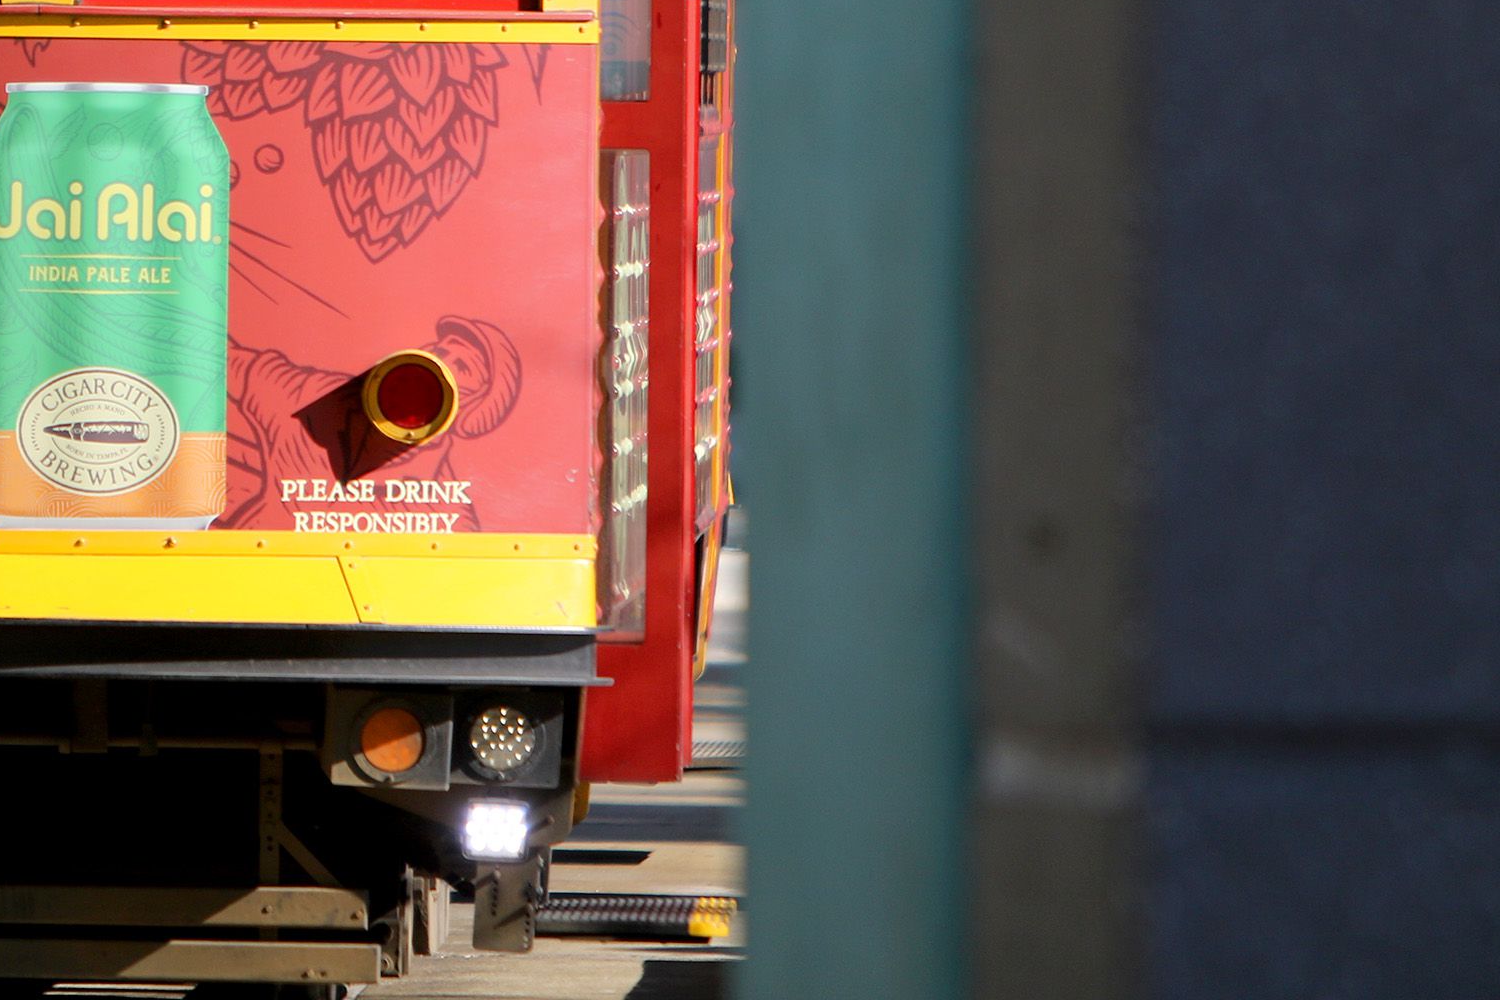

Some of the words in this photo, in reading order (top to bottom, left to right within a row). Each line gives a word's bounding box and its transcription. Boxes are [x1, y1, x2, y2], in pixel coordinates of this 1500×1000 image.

[28, 265, 79, 283] INDIA
[86, 266, 131, 284] PALE
[138, 267, 172, 284] ALE
[41, 378, 106, 412] CIGAR
[110, 379, 158, 414] CITY
[40, 449, 154, 487] BREWING
[281, 478, 375, 502] PLEASE
[385, 479, 472, 505] DRINK
[293, 511, 460, 534] RESPONSIBLY
